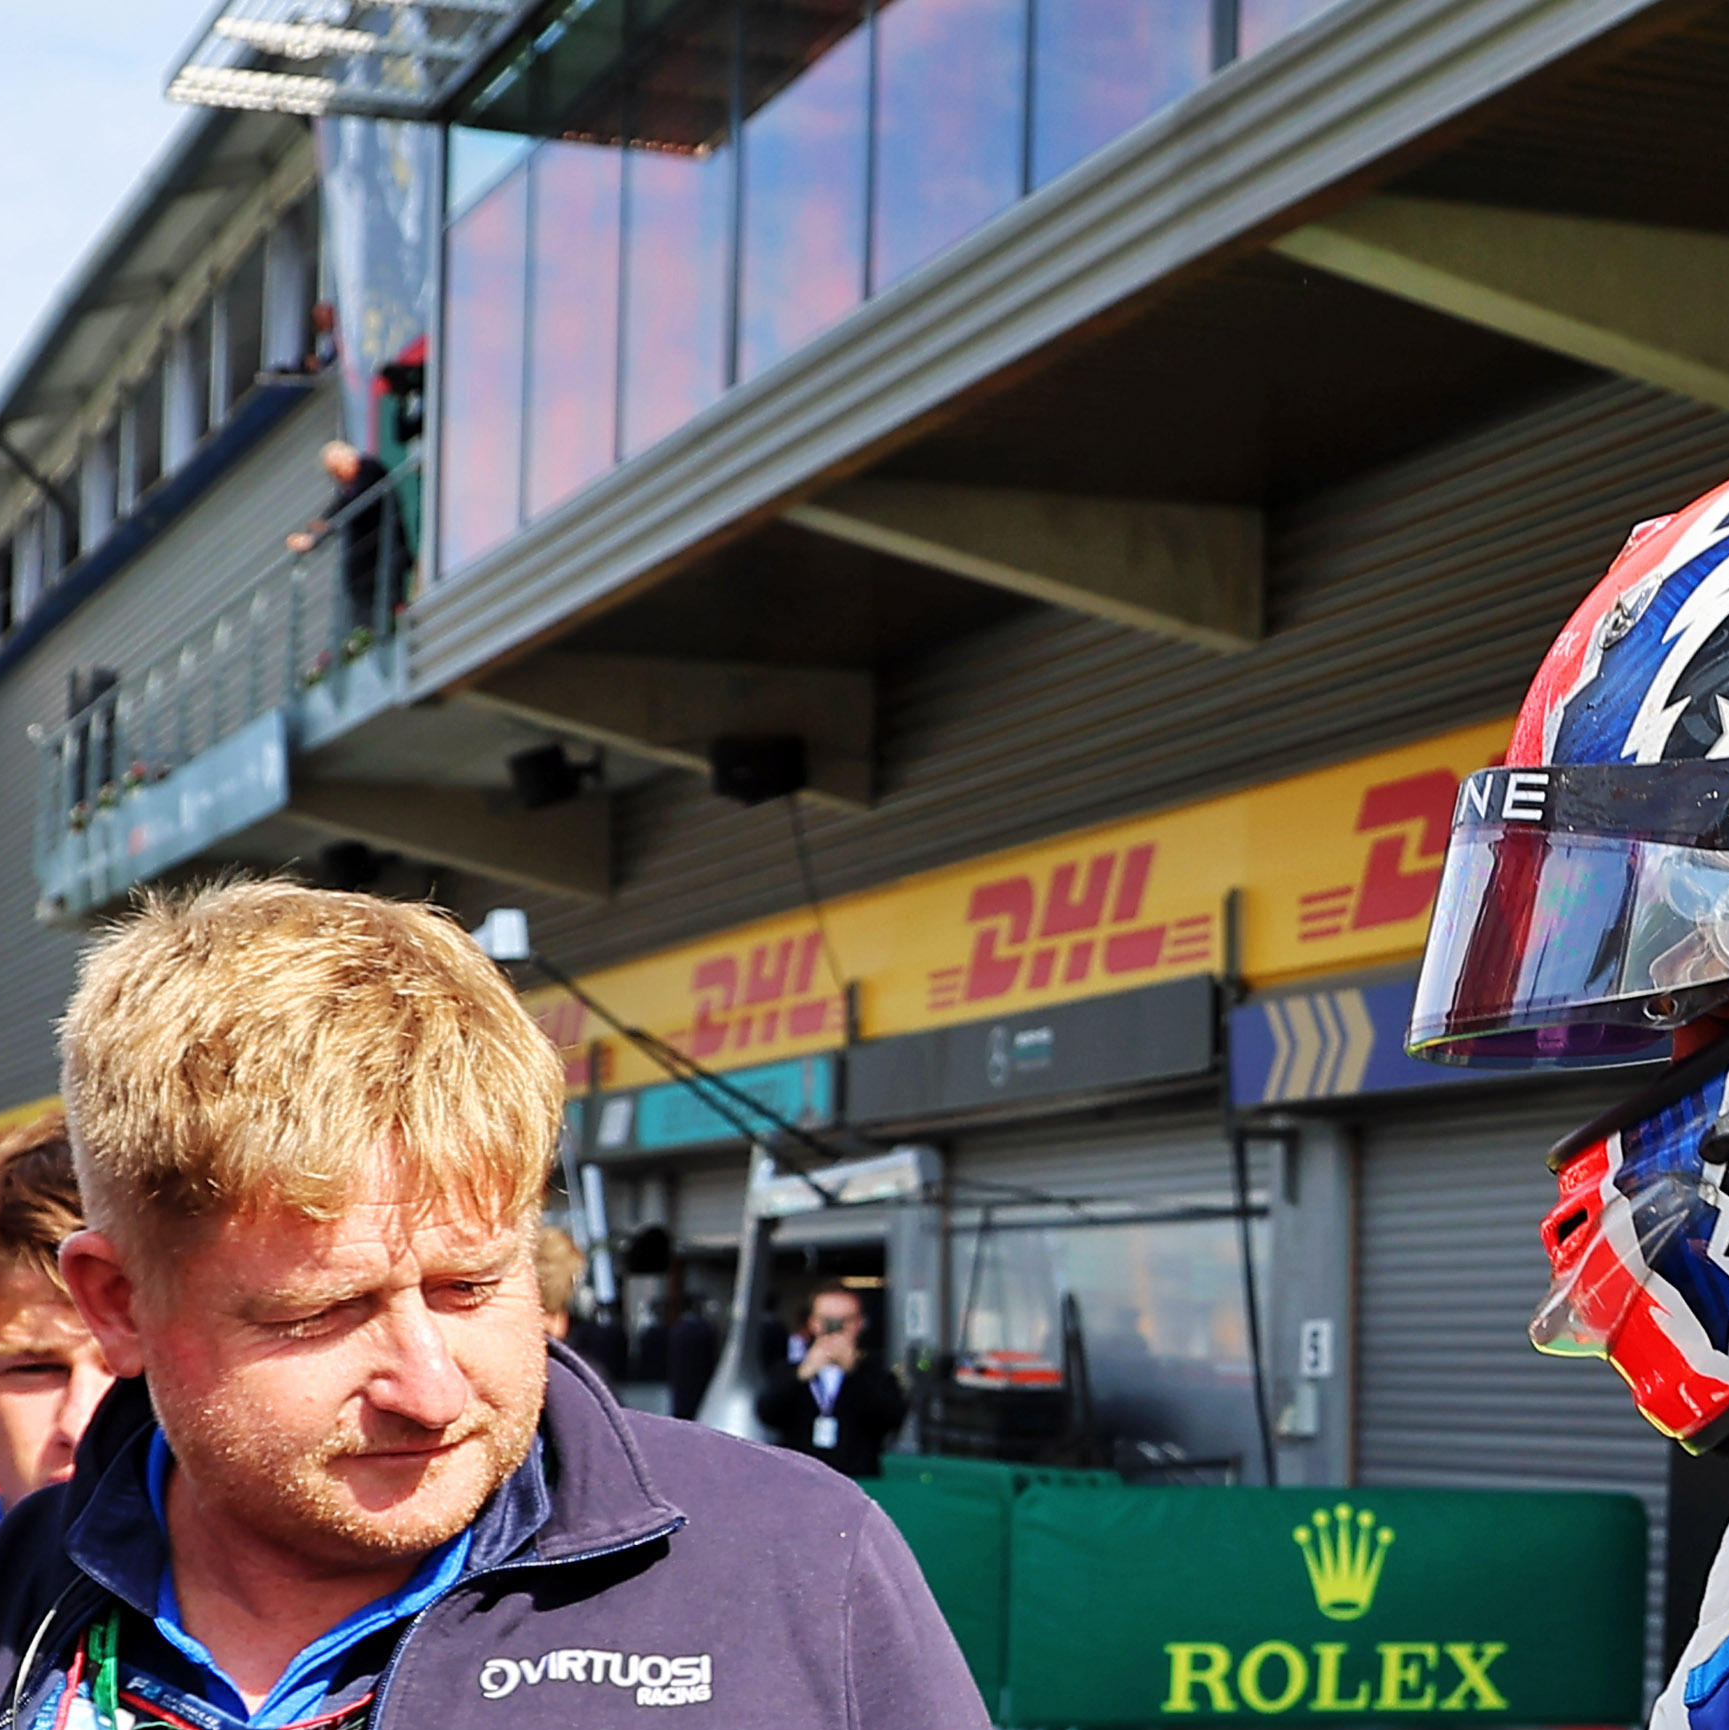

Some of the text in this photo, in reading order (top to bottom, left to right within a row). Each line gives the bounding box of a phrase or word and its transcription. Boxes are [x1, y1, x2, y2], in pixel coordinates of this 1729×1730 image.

[965, 842, 1169, 1001] DHL
[691, 929, 832, 1059] DHL
[519, 1648, 712, 1688] VIRTUOSI
[635, 1684, 713, 1707] RACING
[1161, 1639, 1509, 1715] ROLEX
